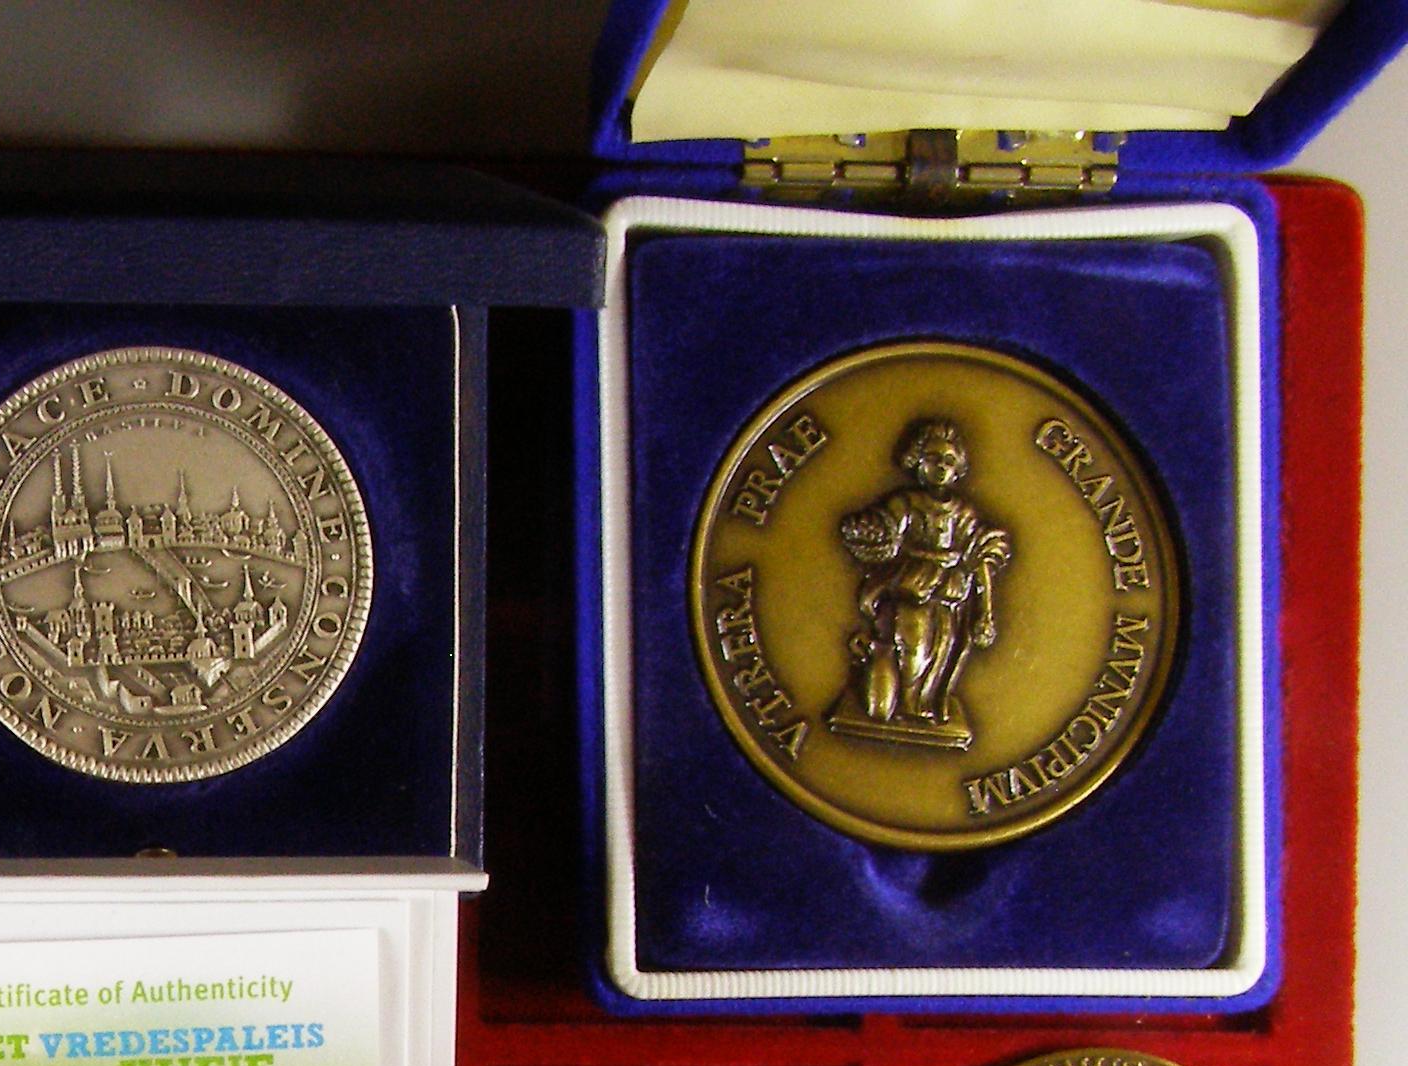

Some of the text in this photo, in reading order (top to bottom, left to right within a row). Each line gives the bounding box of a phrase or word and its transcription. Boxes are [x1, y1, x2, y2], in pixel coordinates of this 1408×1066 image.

[164, 370, 348, 543] DOMINE
[731, 415, 829, 527] PRAE
[1035, 418, 1152, 593] GRANDE
[101, 575, 349, 760] CONSERVA
[38, 1022, 326, 1059] VREDESPALEIS
[98, 980, 124, 1005] of
[132, 975, 294, 1002] Authenticity
